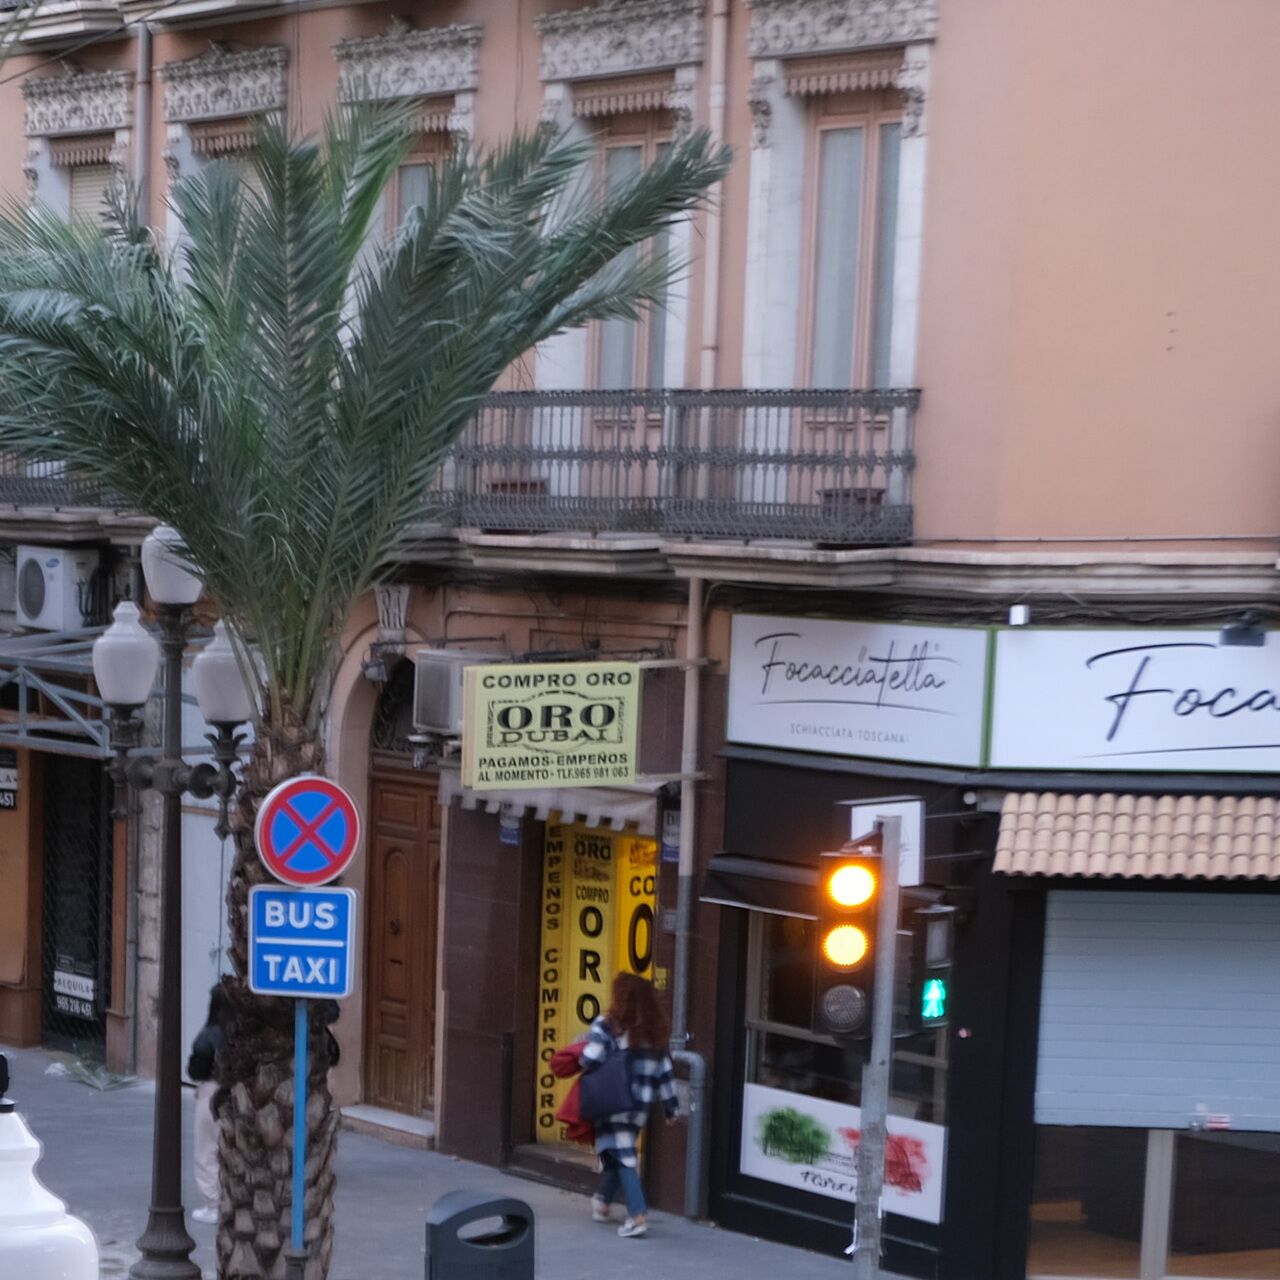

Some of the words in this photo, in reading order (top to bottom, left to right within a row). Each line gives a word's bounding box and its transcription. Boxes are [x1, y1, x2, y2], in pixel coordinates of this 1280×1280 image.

[482, 673, 577, 690] COMPRO
[586, 671, 632, 687] ORO
[497, 703, 616, 730] ORO
[500, 728, 608, 744] DUBAI
[478, 770, 490, 782] AL
[494, 769, 549, 782] MOMENTO
[574, 841, 612, 861] ORO
[575, 885, 609, 903] COMPRO
[629, 875, 655, 897] CO
[265, 900, 336, 930] BUS
[263, 955, 336, 985] TAXI
[539, 1073, 556, 1129] ORO
